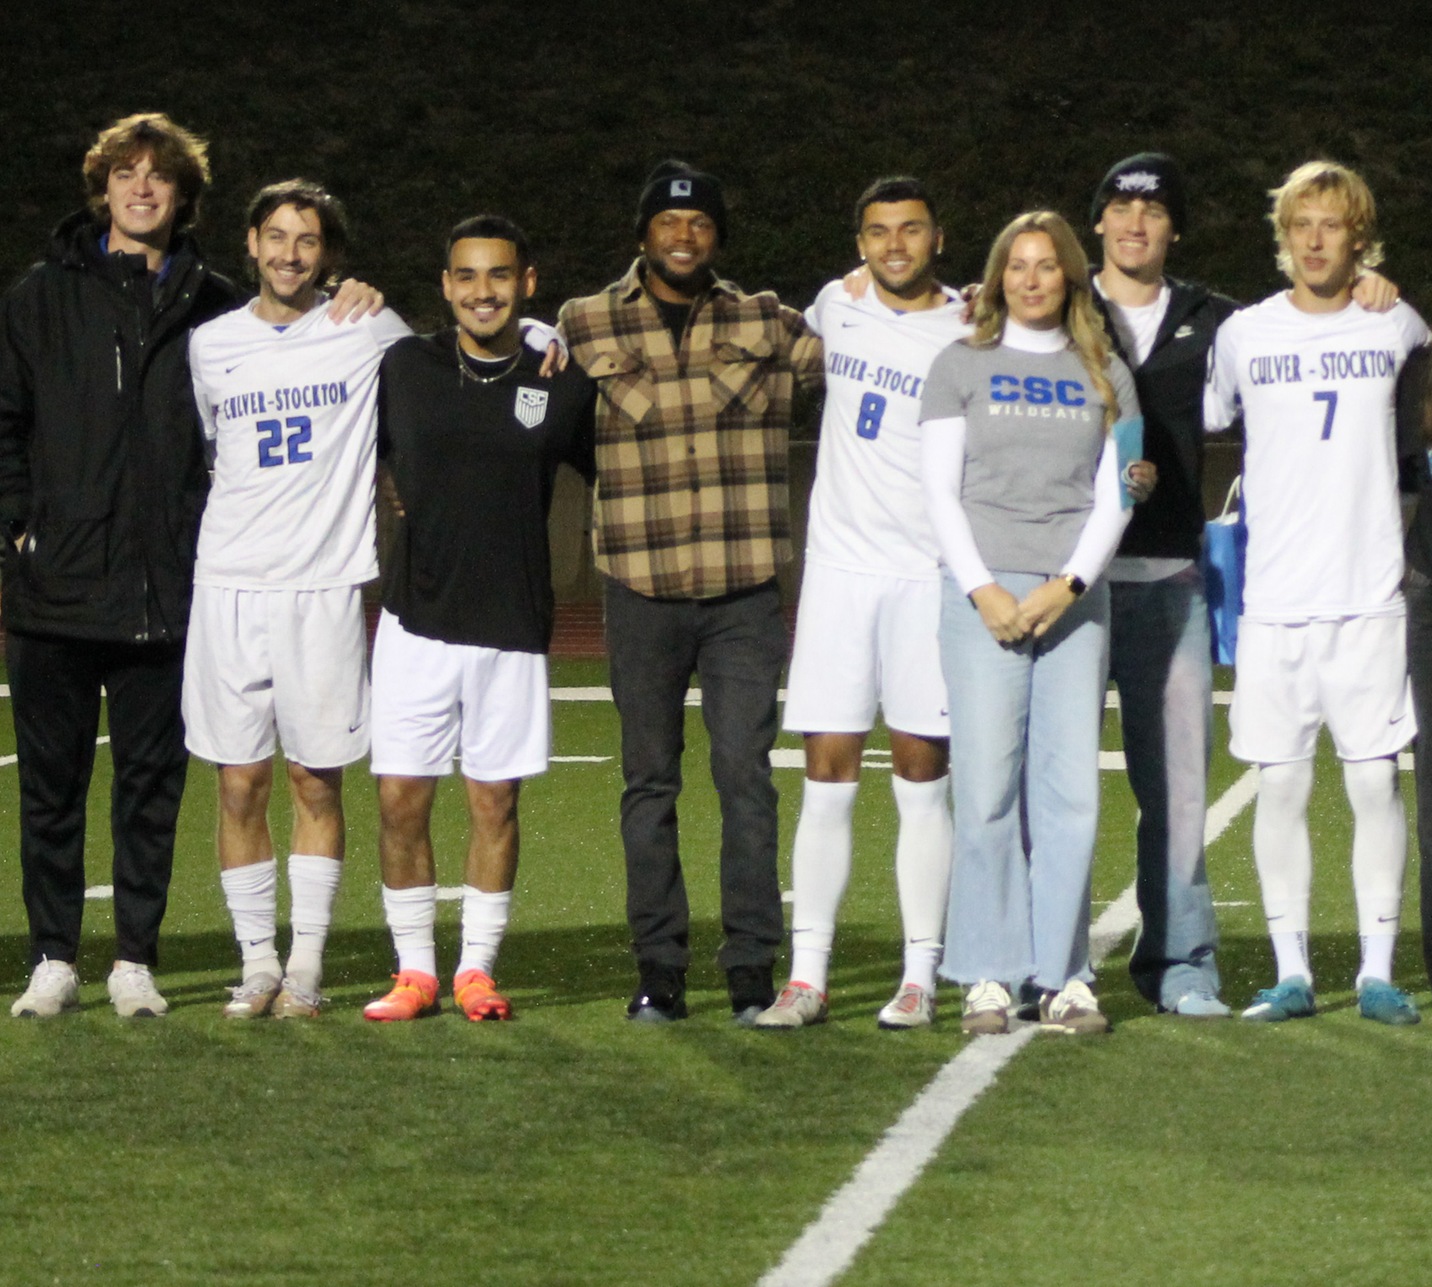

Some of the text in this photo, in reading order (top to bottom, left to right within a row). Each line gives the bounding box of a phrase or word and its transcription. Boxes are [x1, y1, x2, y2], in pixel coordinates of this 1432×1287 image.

[1250, 354, 1302, 386] CULVER
[1320, 350, 1396, 380] STOCKTON
[223, 381, 348, 420] CULVER-STOCKTON
[991, 375, 1086, 406] CSC
[857, 391, 887, 440] 8
[988, 404, 1090, 421] WILDCATS
[1313, 390, 1338, 440] 7
[256, 415, 313, 468] 22
